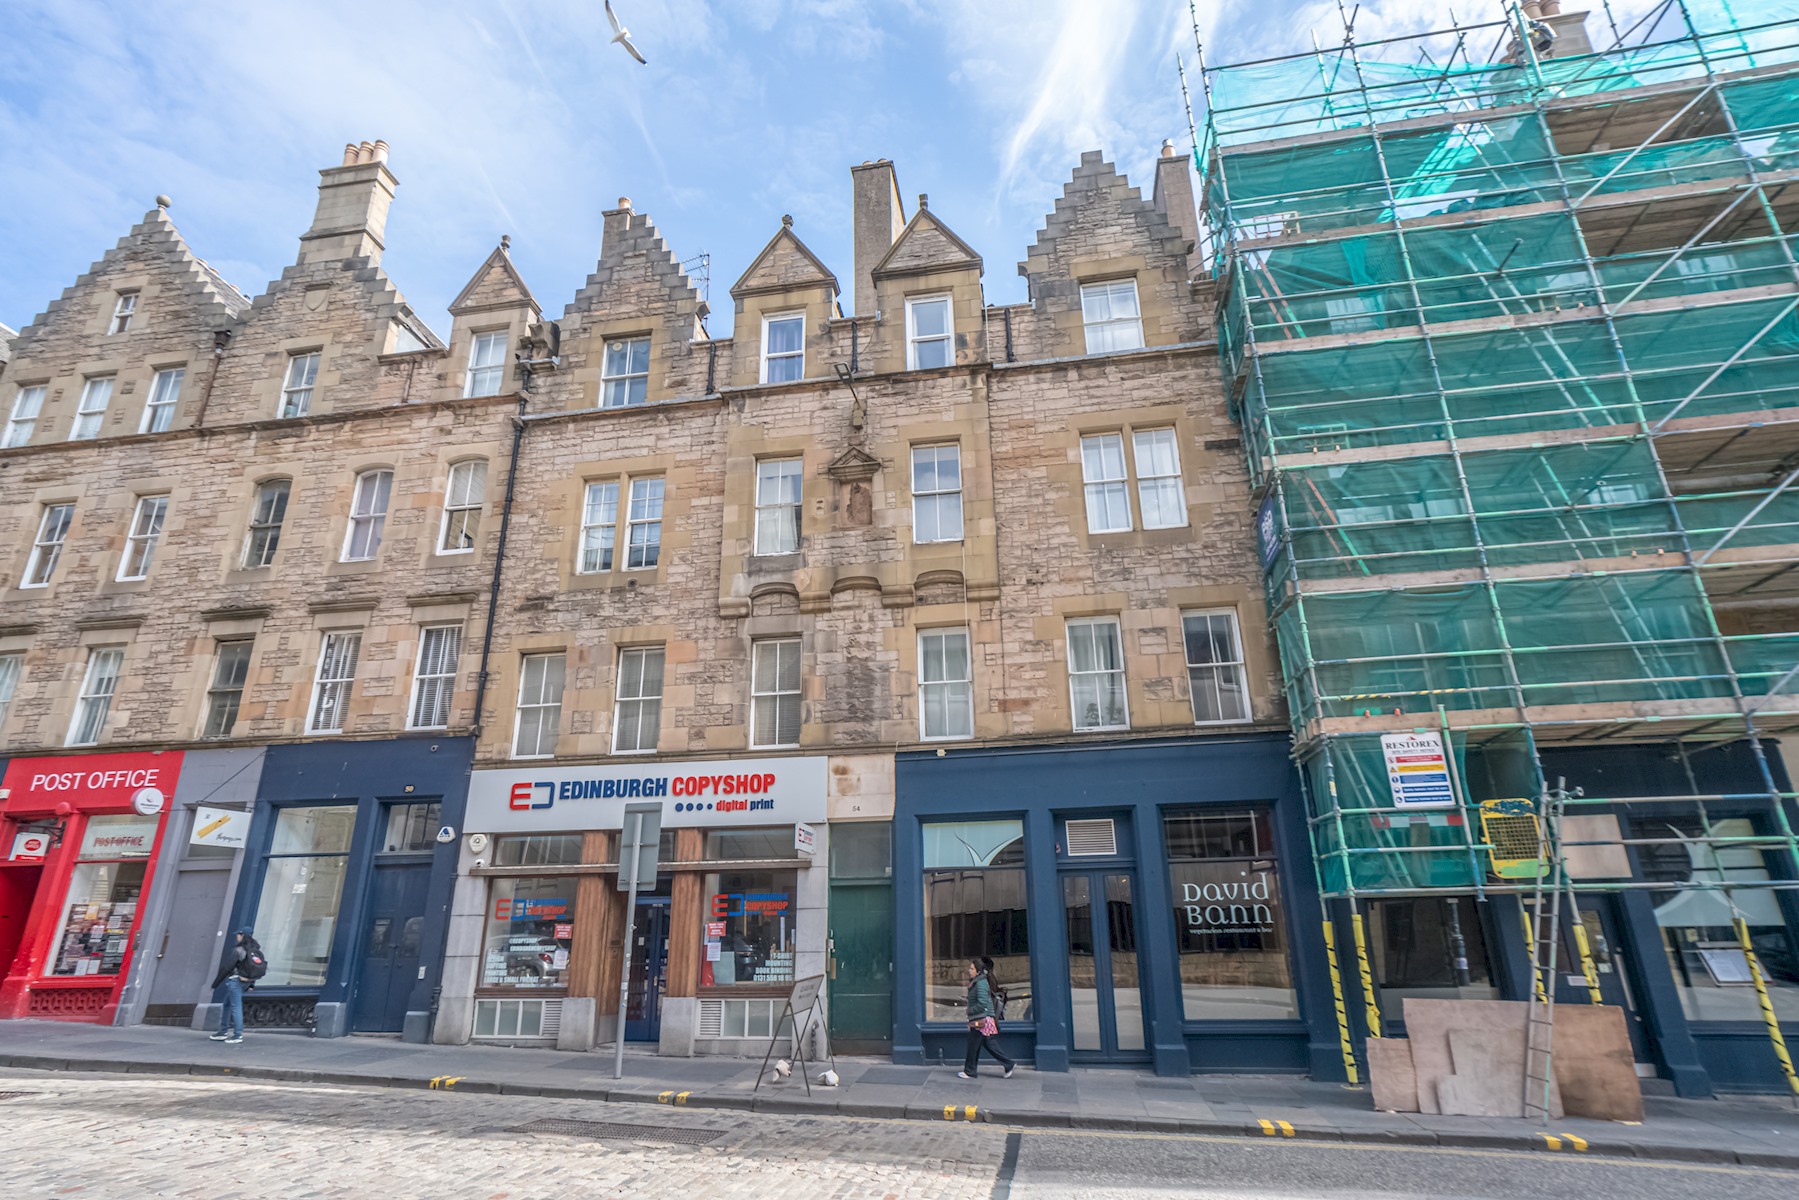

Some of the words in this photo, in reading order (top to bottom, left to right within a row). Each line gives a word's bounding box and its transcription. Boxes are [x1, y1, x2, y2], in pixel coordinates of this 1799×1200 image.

[1385, 740, 1440, 749] RESTOREX
[30, 772, 86, 792] POST
[87, 769, 160, 789] OFFICE
[559, 777, 669, 800] EDINBURGH
[671, 773, 776, 797] COPYSHOP
[715, 799, 748, 812] digital
[749, 799, 775, 811] print
[1182, 871, 1269, 902] David
[745, 901, 789, 911] COPYSHOP
[1184, 903, 1275, 926] Bann
[753, 974, 766, 982] 0131
